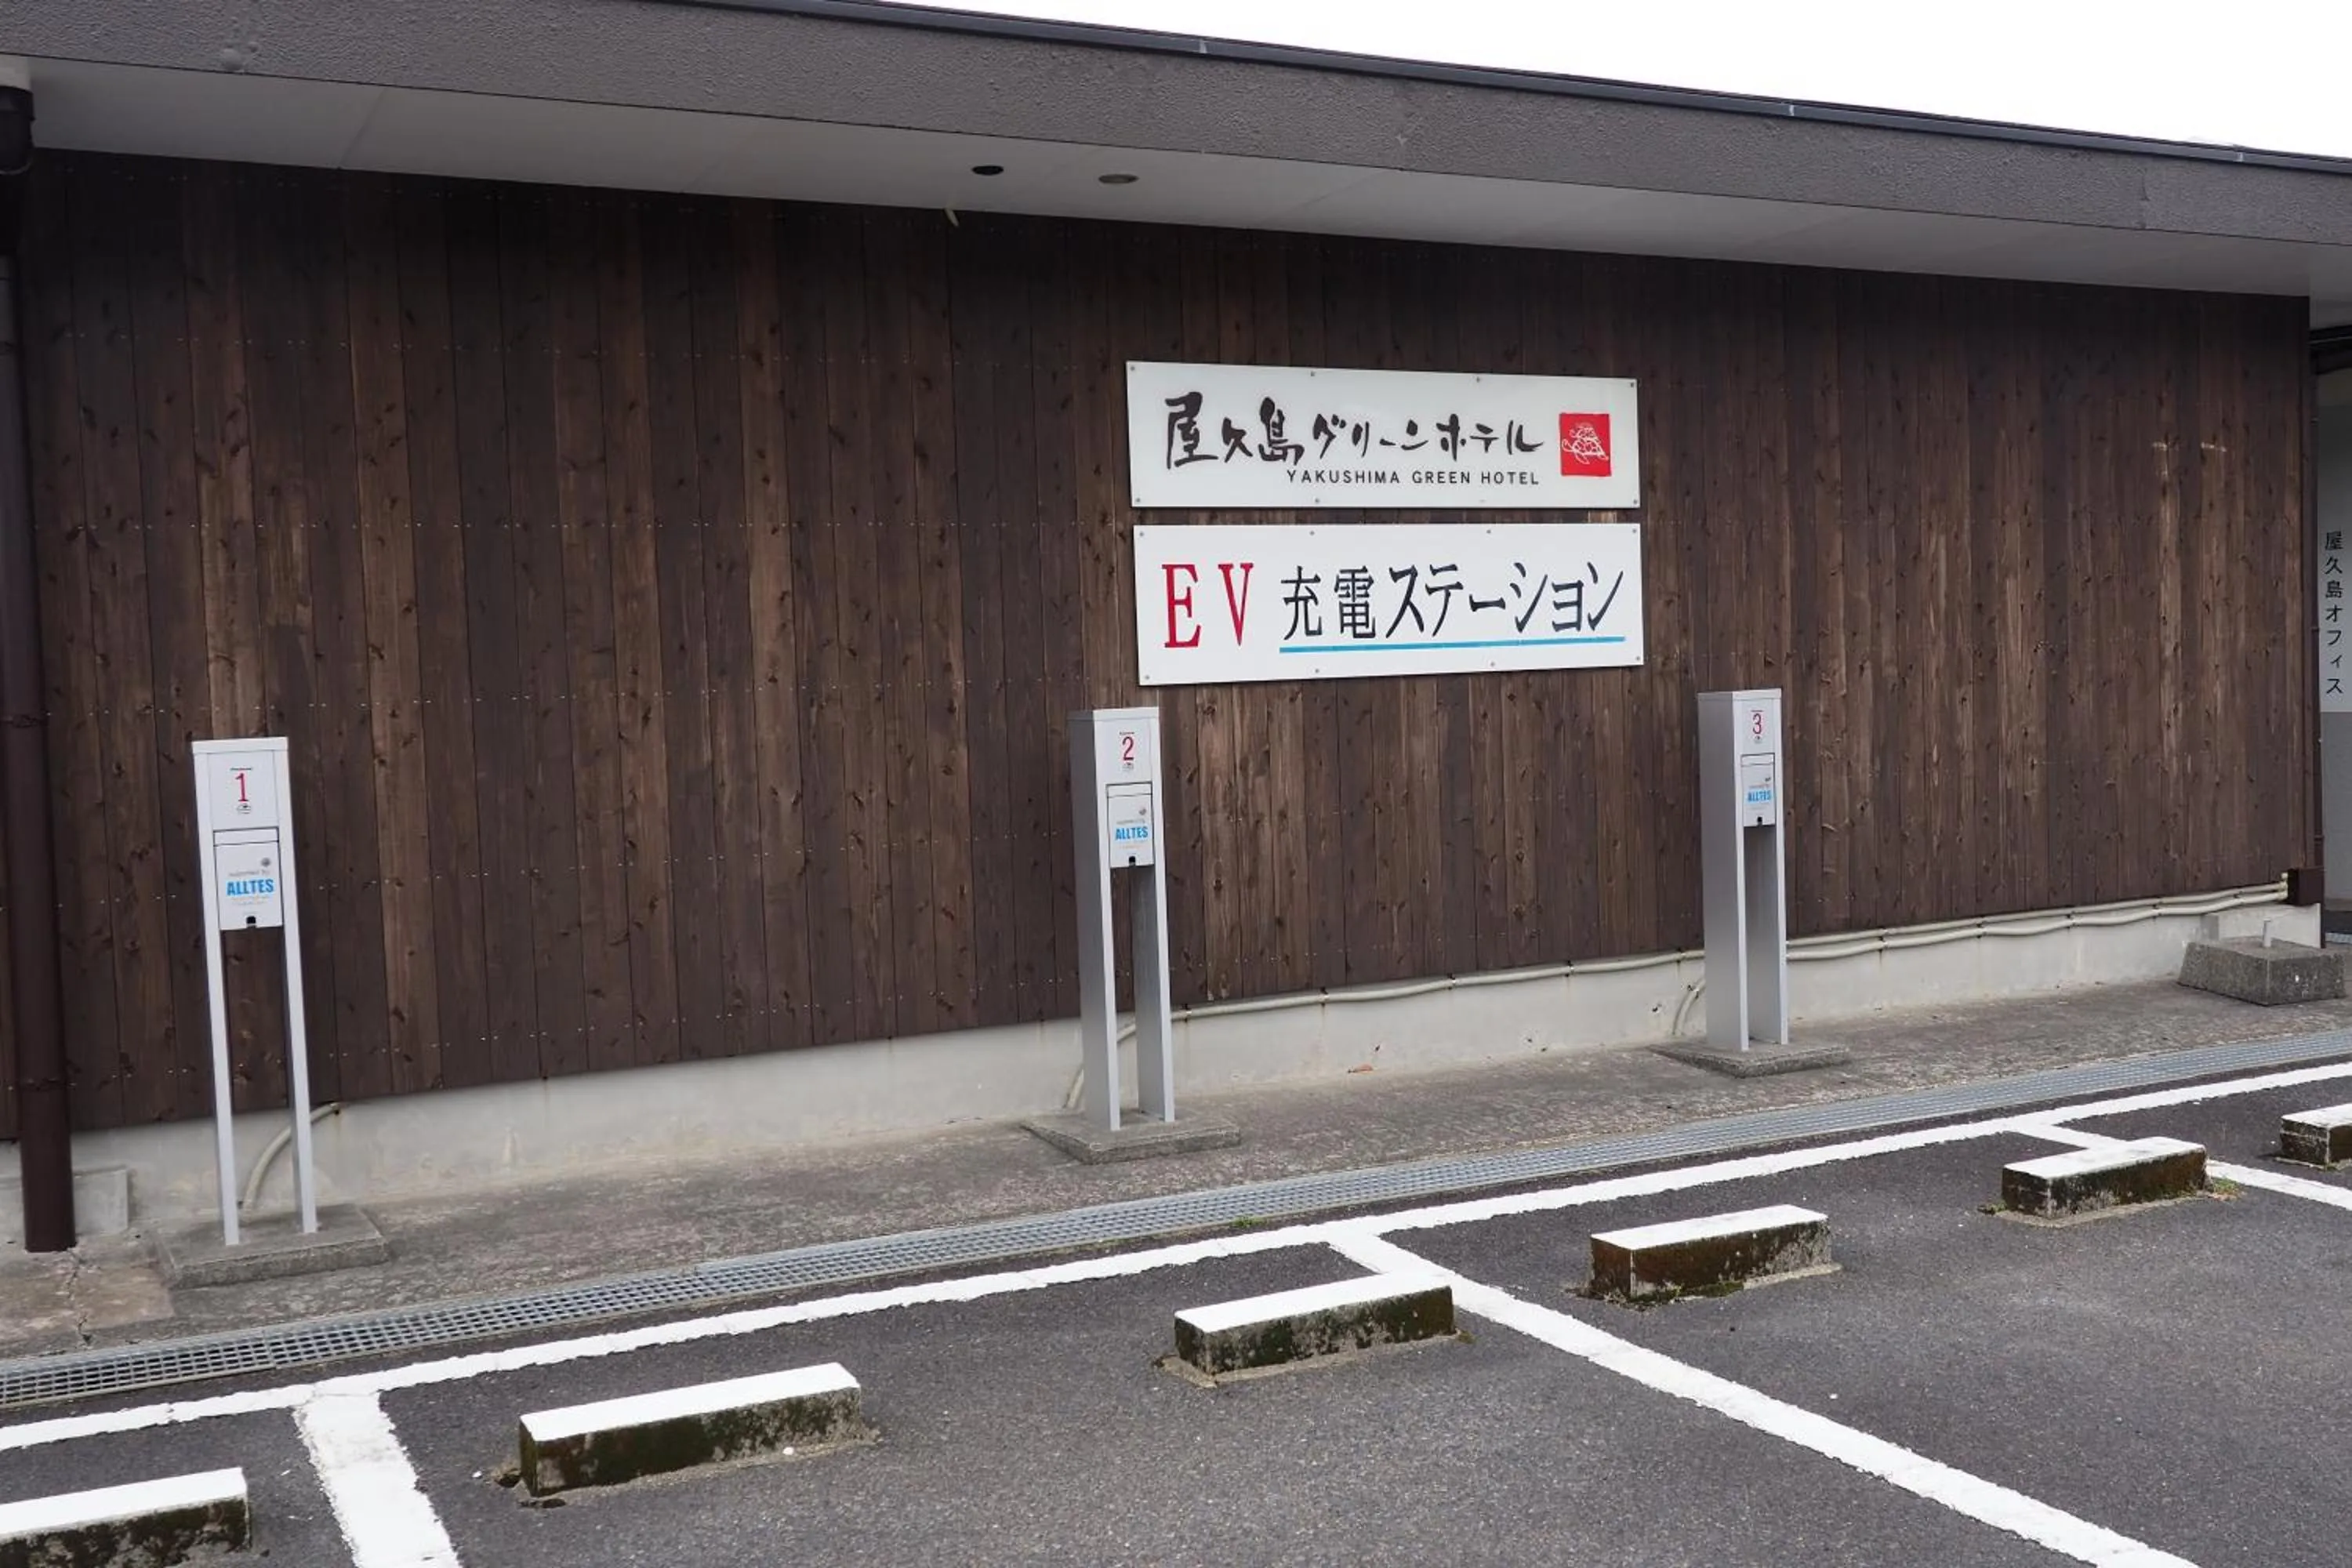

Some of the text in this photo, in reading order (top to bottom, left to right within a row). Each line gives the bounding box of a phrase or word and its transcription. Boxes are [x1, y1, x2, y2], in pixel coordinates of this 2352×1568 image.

[1165, 390, 1544, 470] 屋久島グリーンホテル
[1287, 470, 1539, 485] YAKUSHIMA GREEN HOTEL
[1162, 561, 1625, 648] EV 充電ステーション
[2325, 530, 2343, 695] 屋久島オフィス
[1752, 713, 1762, 735] 3
[1122, 736, 1135, 761] 2
[235, 772, 249, 802] 1
[1115, 826, 1149, 841] ALLTES
[227, 879, 274, 896] ALLTES
